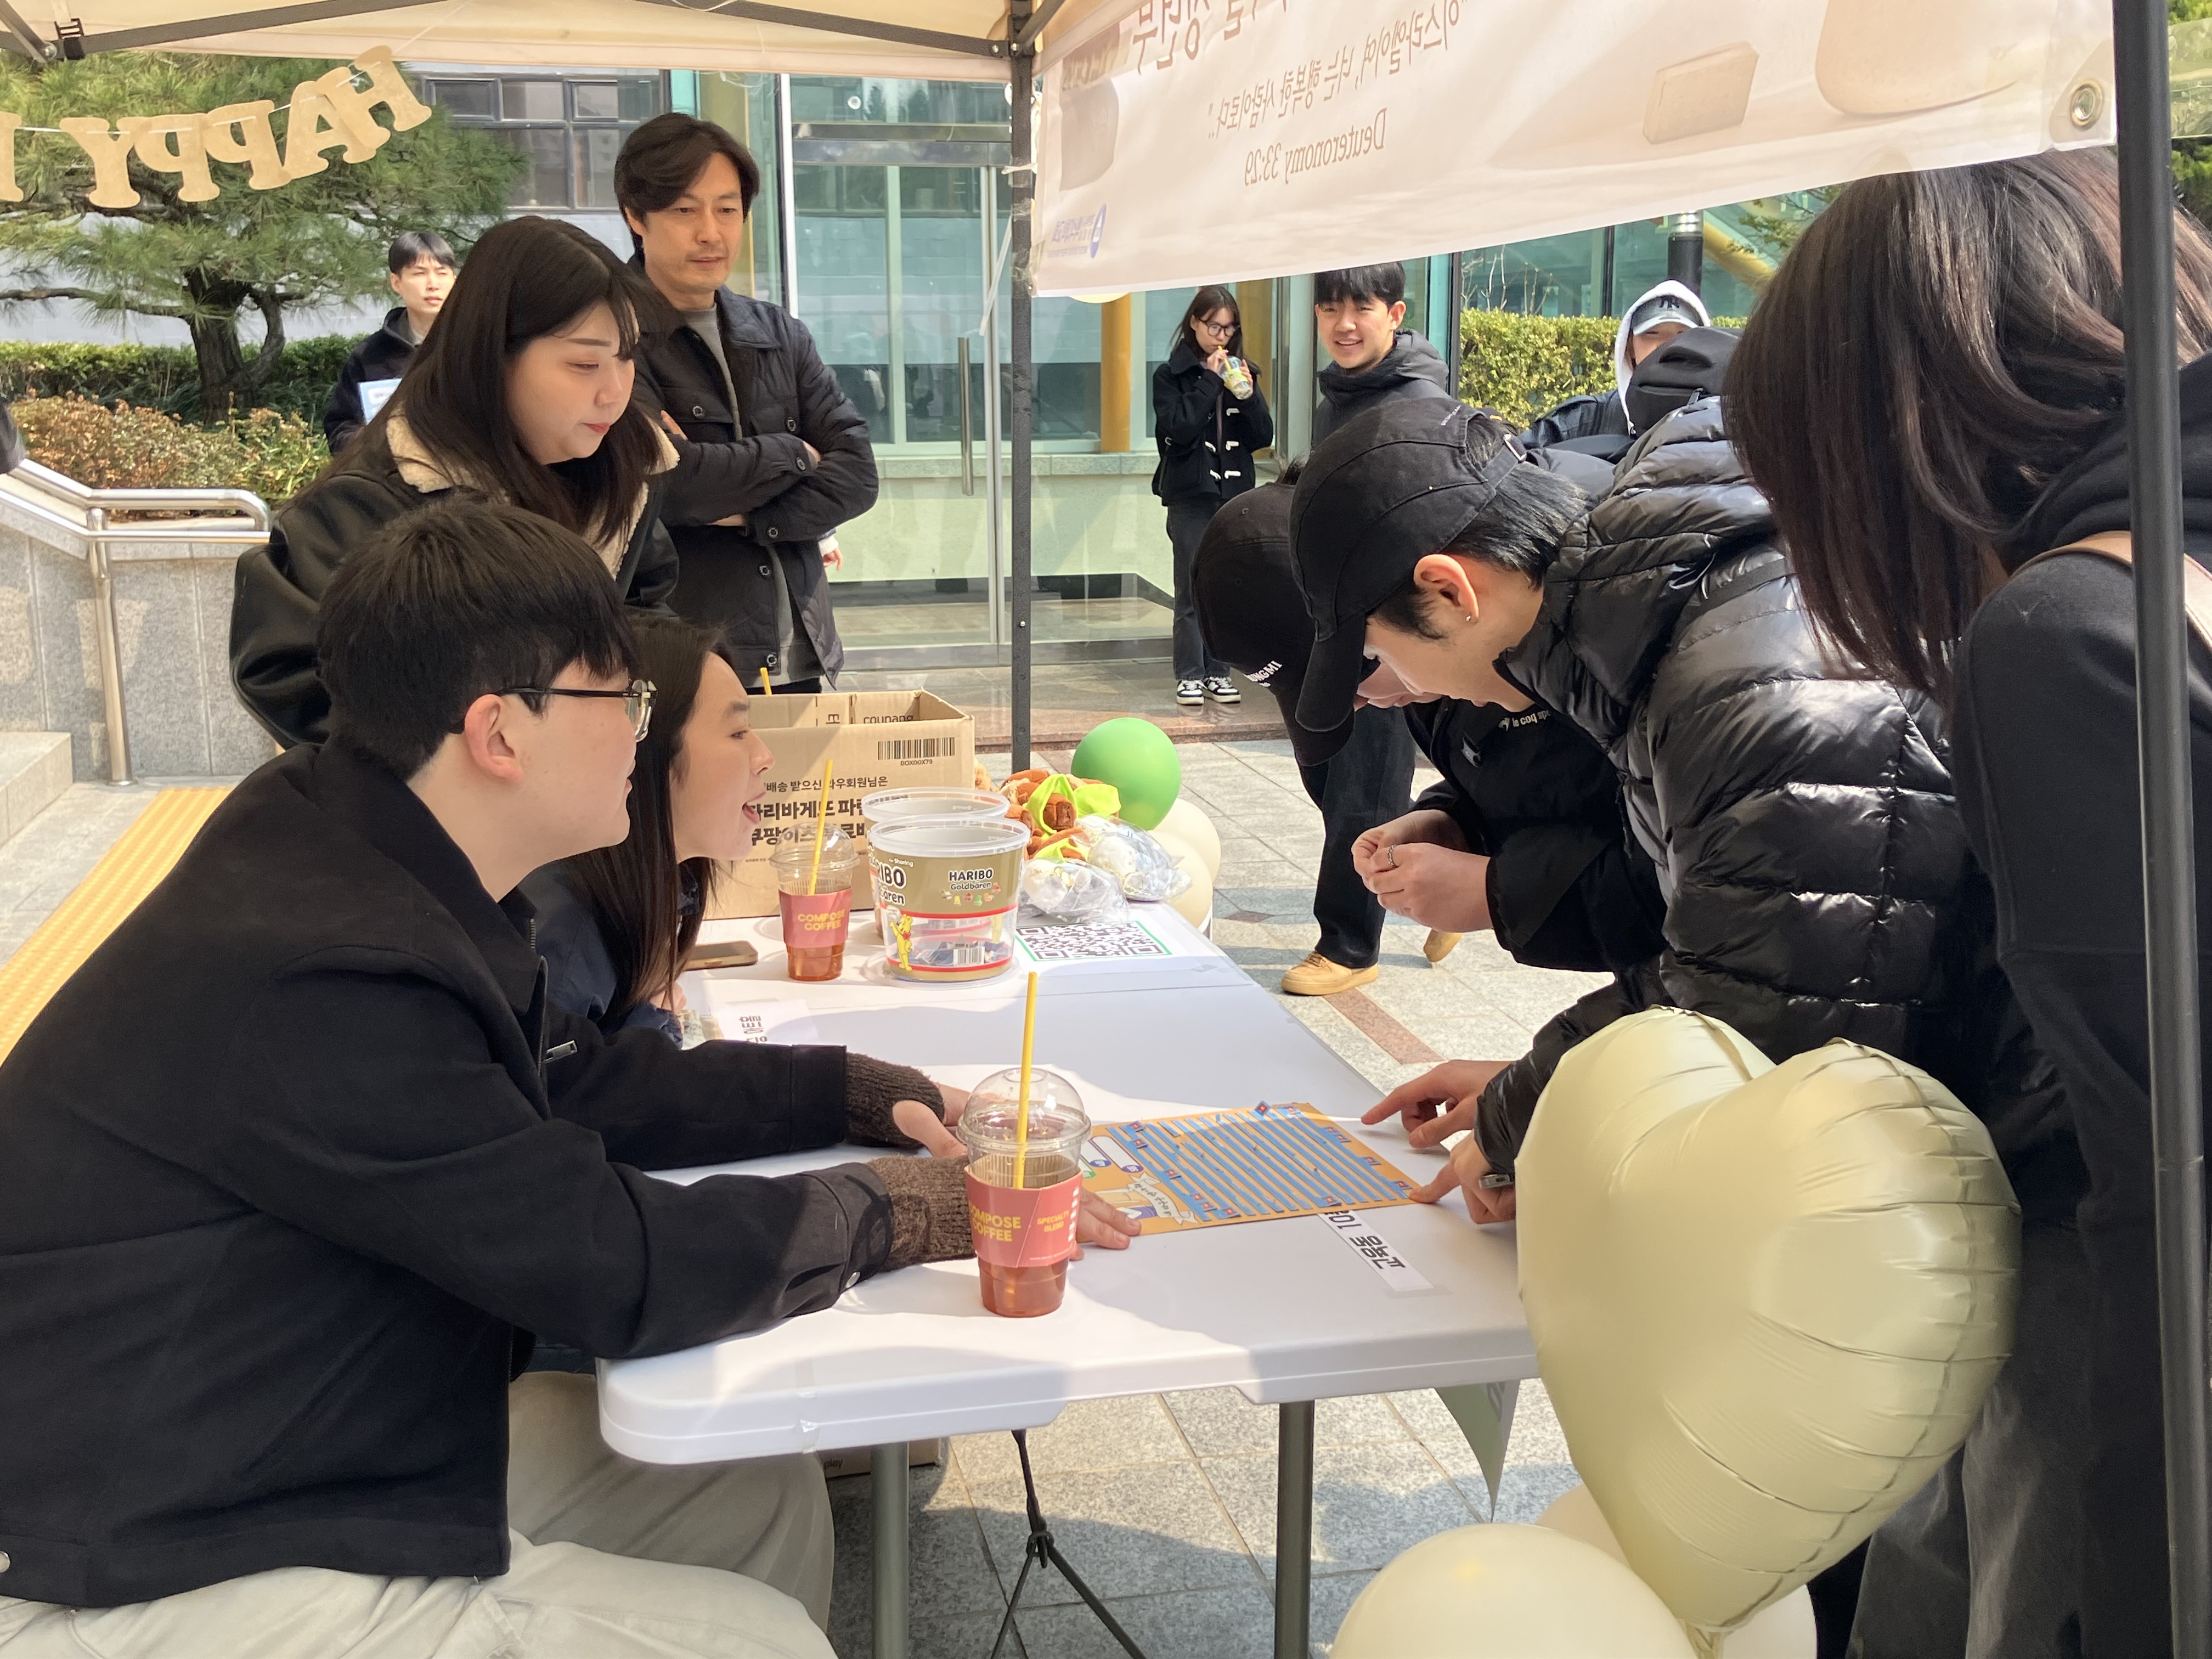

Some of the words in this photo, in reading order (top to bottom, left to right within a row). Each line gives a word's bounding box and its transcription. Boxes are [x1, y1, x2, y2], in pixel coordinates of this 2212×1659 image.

[1520, 713, 1537, 726] coq
[764, 781, 788, 793] 배송
[791, 780, 822, 792] 받으신
[949, 868, 994, 882] HARIBO
[950, 881, 991, 890] Goldbären
[797, 909, 845, 923] COMPOSE
[804, 919, 842, 932] COFFEE
[1037, 1210, 1069, 1224] SPECIALTY
[972, 1217, 1013, 1242] COFFEE
[1044, 1221, 1064, 1232] BLEND
[1348, 1235, 1406, 1269] 교육동
